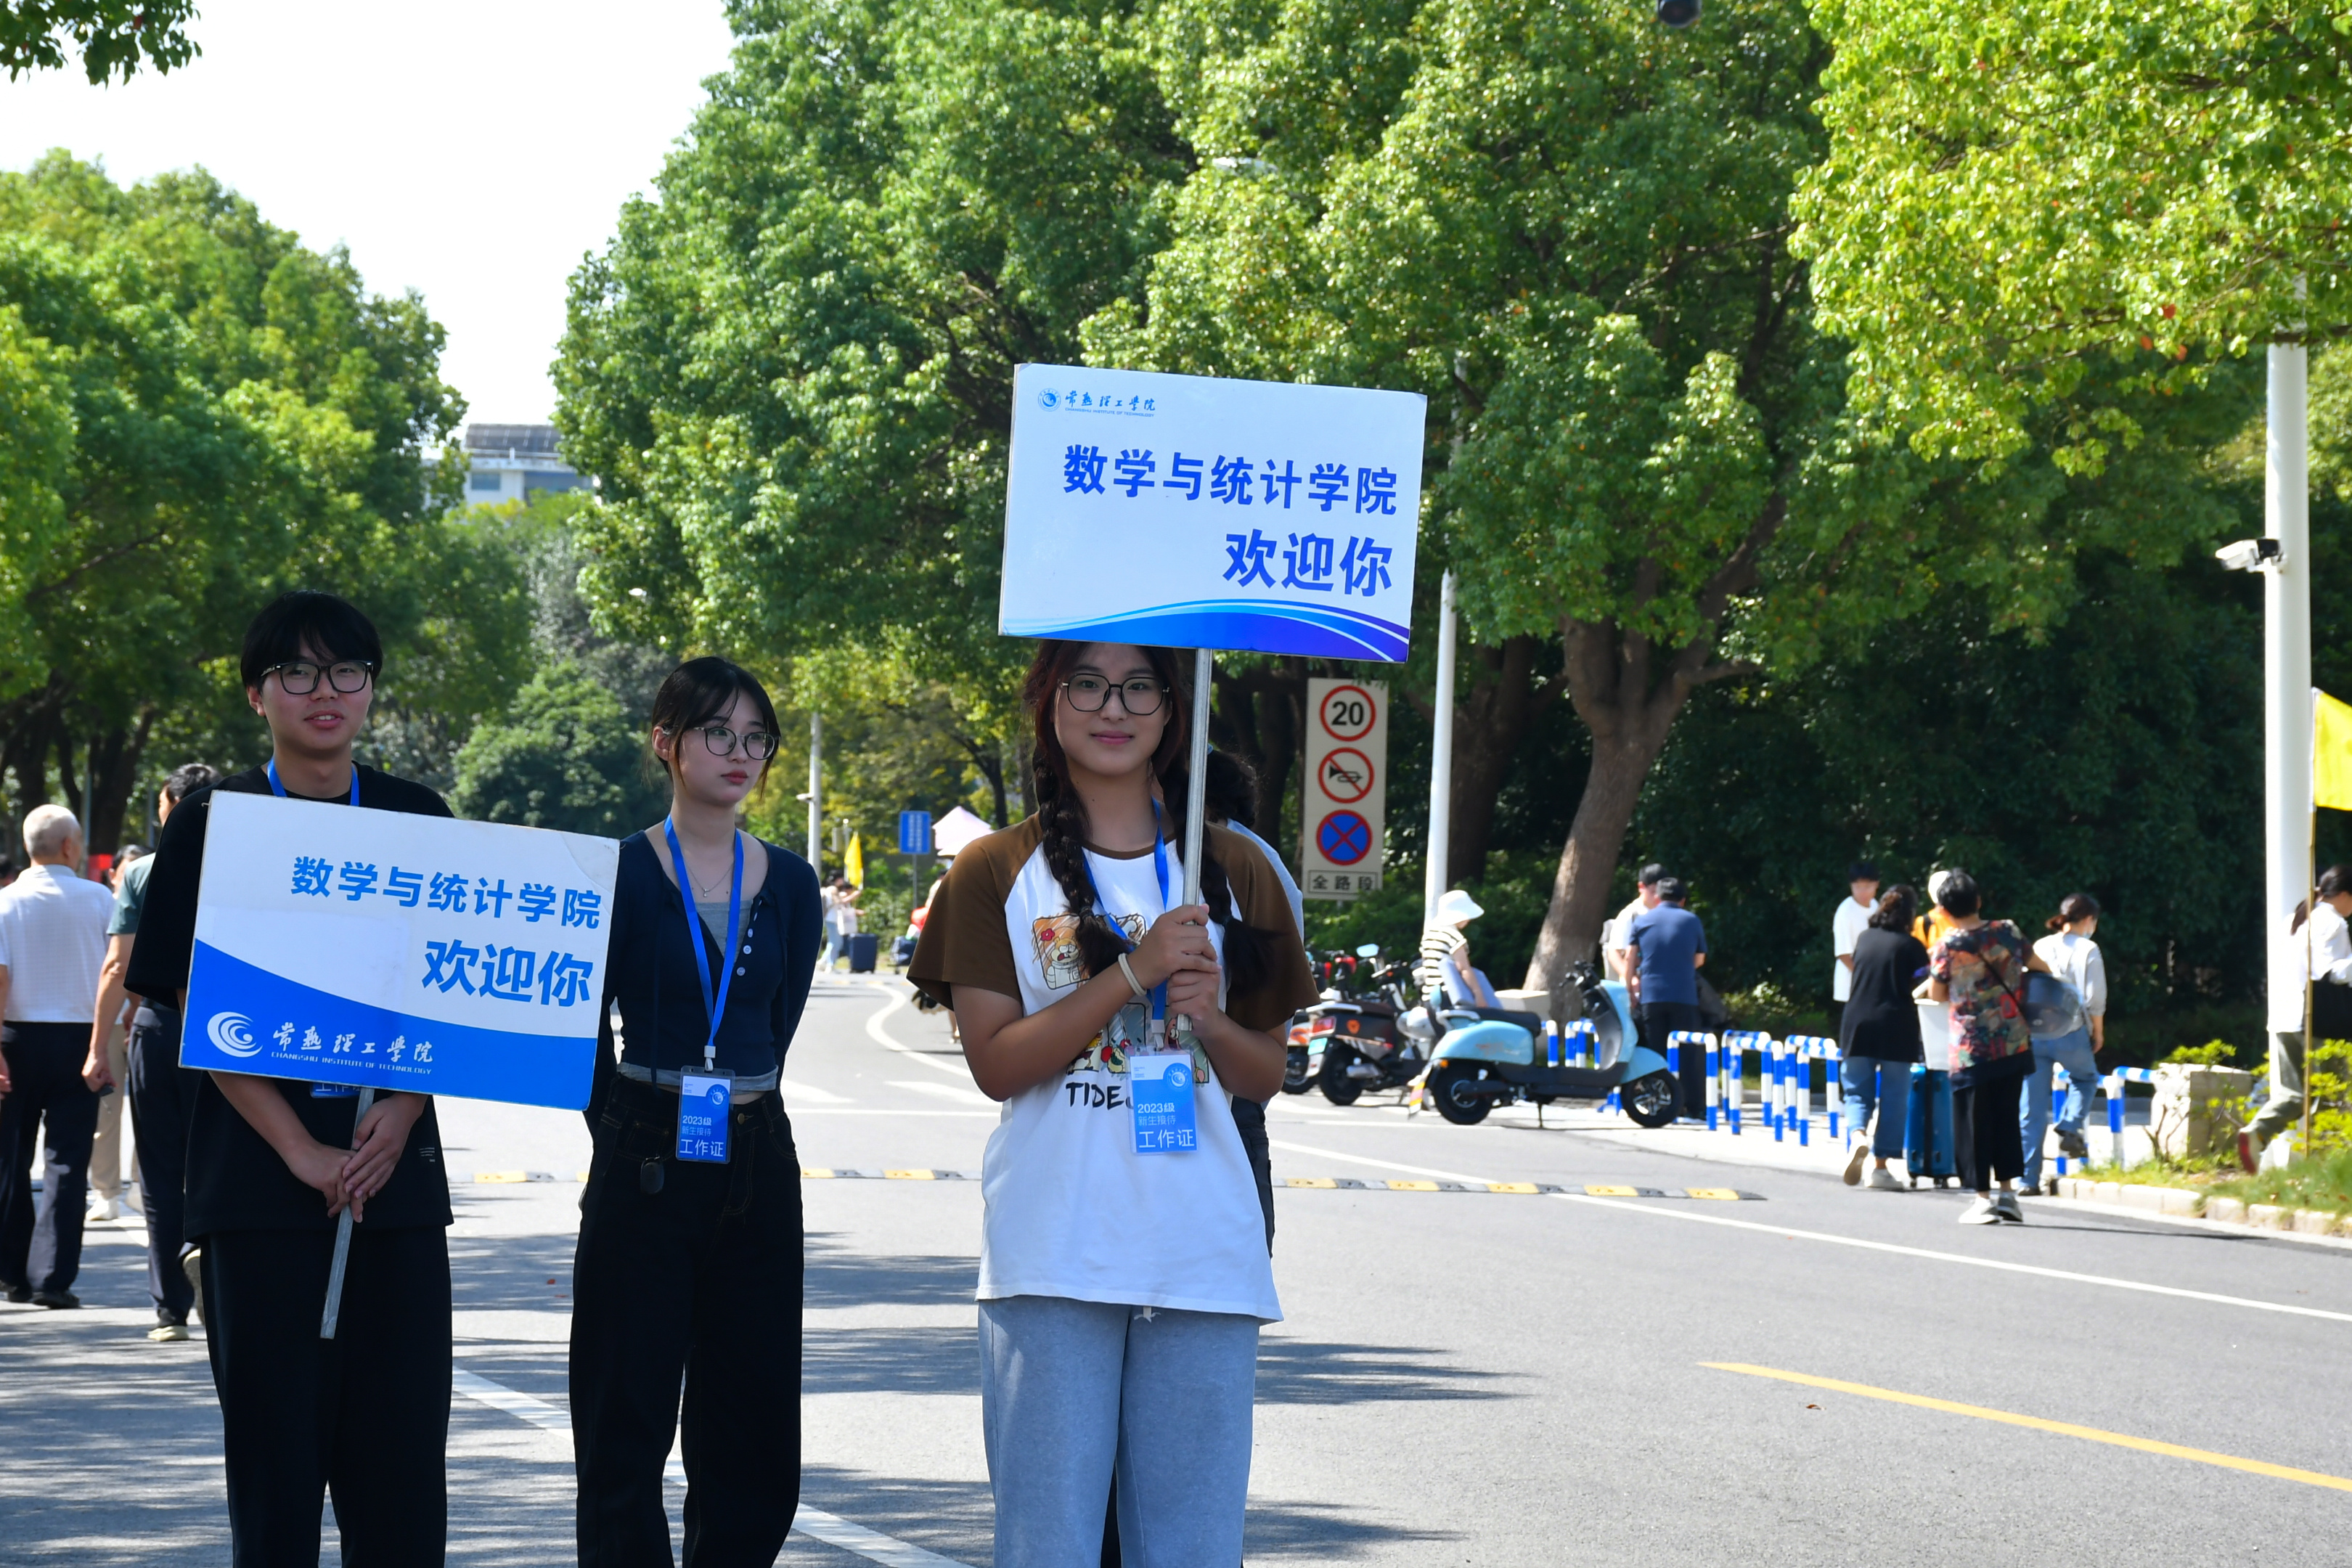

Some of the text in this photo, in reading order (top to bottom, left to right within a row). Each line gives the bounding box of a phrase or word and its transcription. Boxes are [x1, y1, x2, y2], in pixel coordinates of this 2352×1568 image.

[1063, 444, 1397, 515] 数学与统计学院
[1222, 528, 1393, 597] 欢迎你
[1331, 701, 1364, 726] 20
[290, 856, 602, 929] 数学与统计学院
[1312, 874, 1373, 892] 全路段
[422, 939, 594, 1008] 欢迎你
[271, 1051, 319, 1062] CHANGSHU
[322, 1057, 363, 1067] INSTITUTE
[379, 1063, 432, 1074] TECHNOLOGY
[1138, 1102, 1175, 1114] 2023级
[682, 1115, 712, 1126] 2023级
[1138, 1115, 1176, 1126] 新生接待
[682, 1126, 712, 1137] 新生接待
[1138, 1129, 1195, 1148] 工作证
[679, 1138, 724, 1157] 工作证
